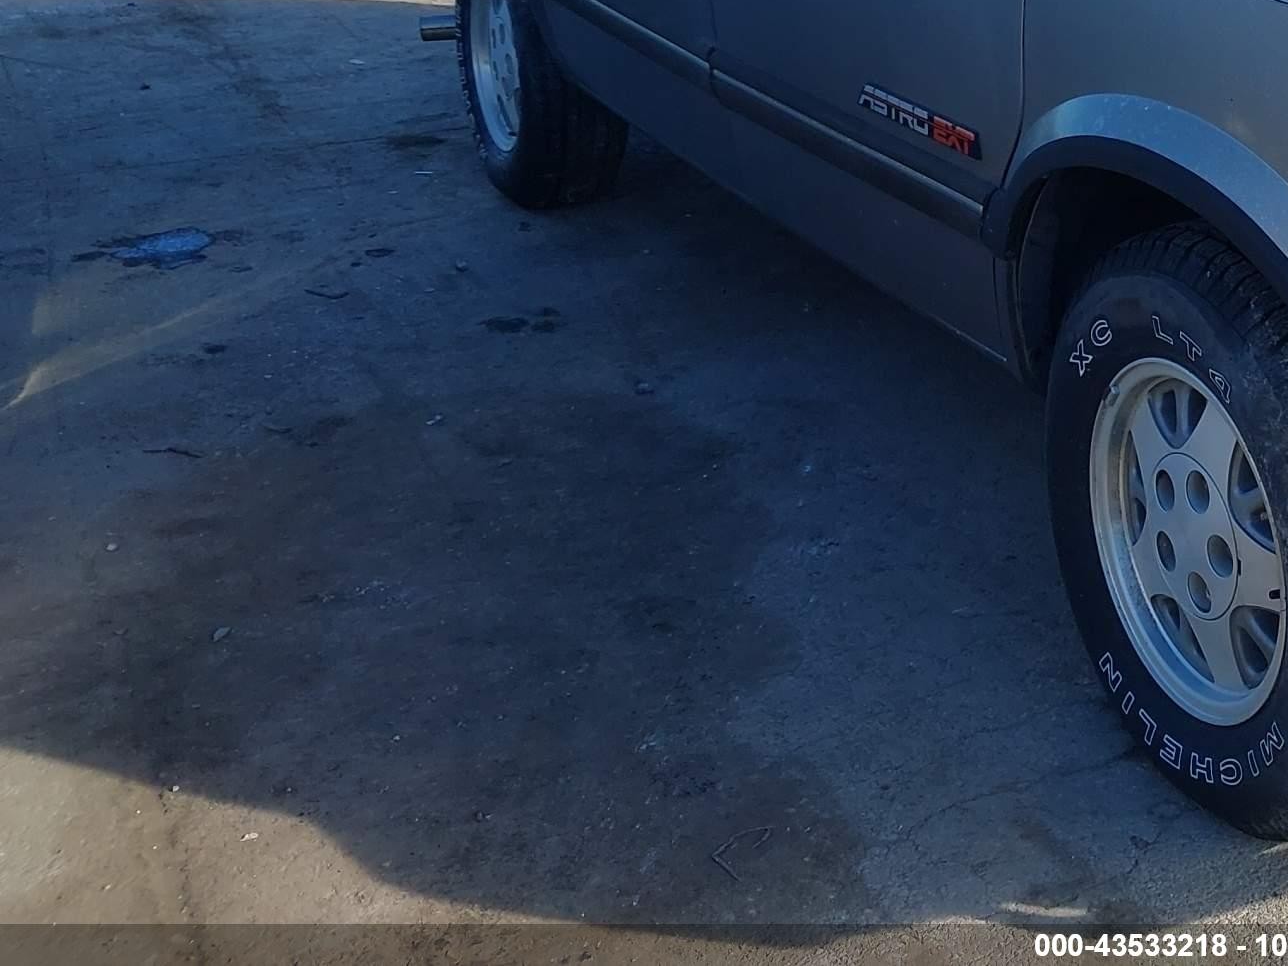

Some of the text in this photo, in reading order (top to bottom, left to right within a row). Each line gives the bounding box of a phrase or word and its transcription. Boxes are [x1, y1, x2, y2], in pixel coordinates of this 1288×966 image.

[858, 83, 976, 155] ASTRO EXT
[1069, 319, 1113, 378] XC
[1099, 651, 1286, 786] MICHELIN
